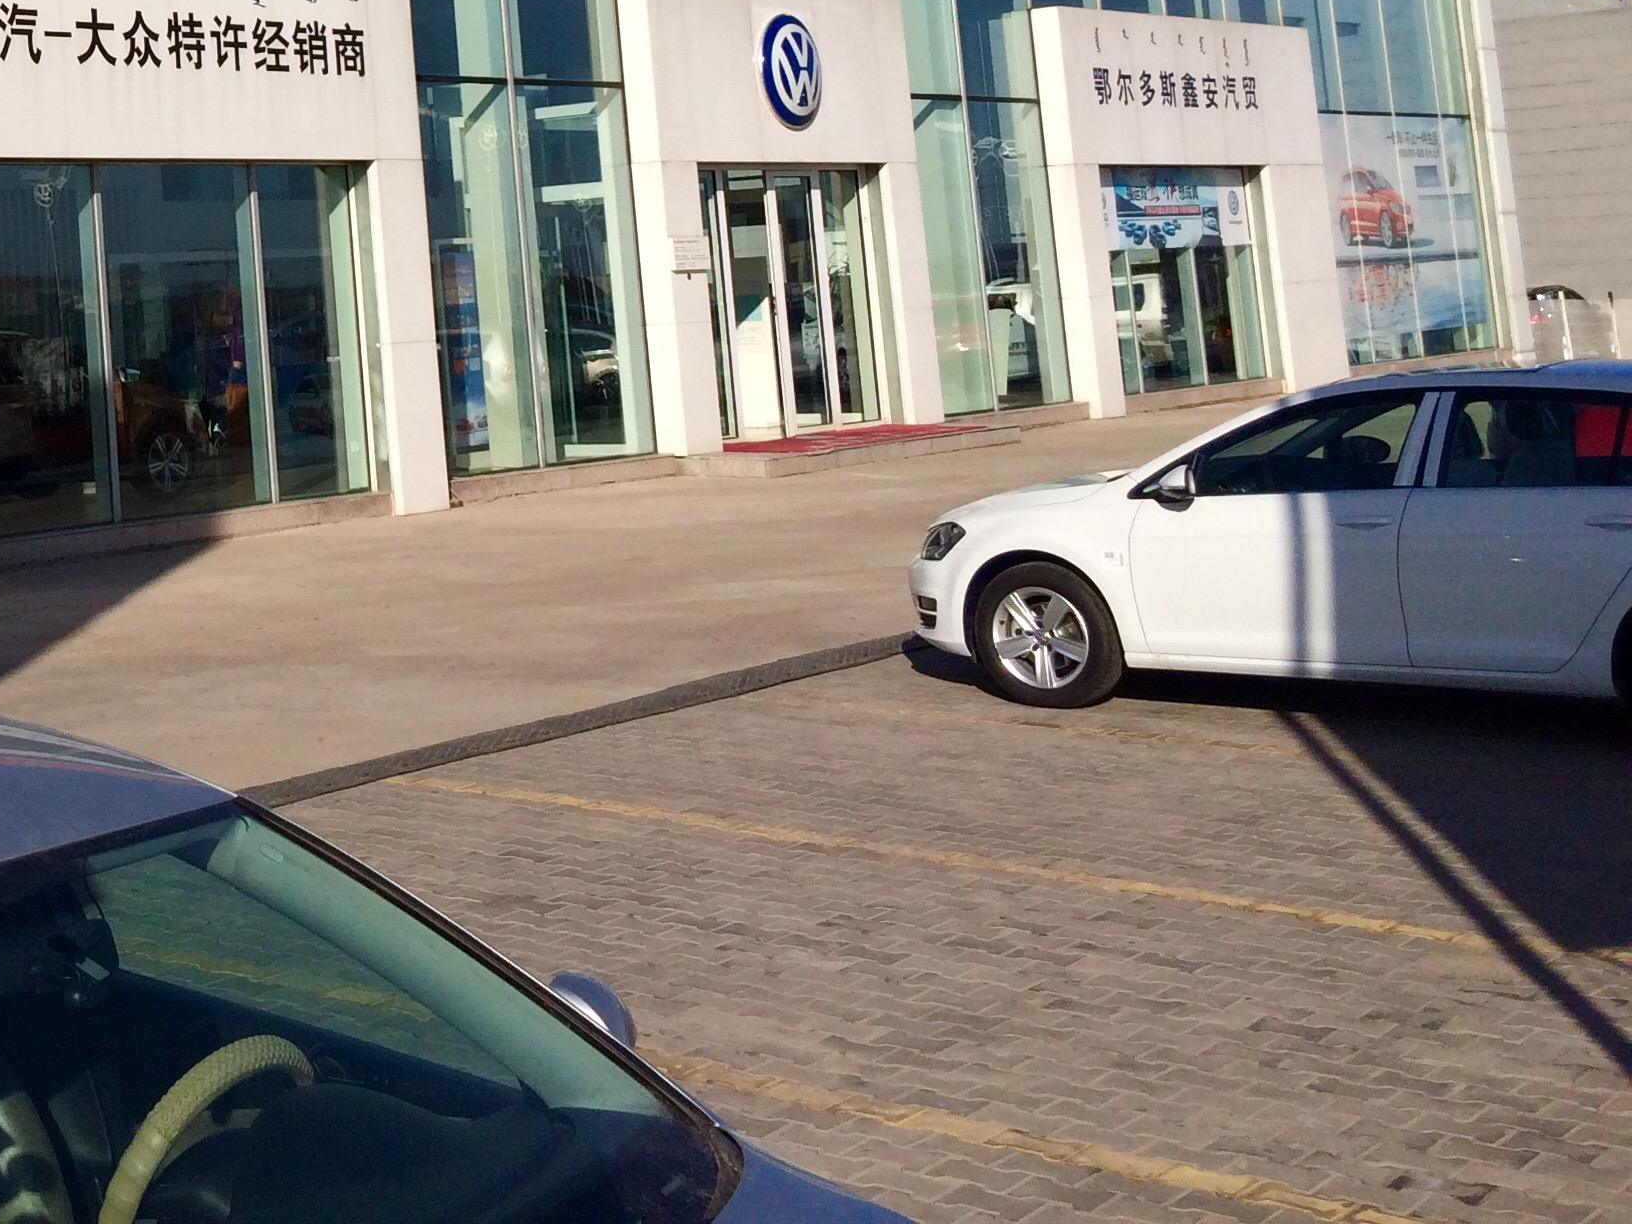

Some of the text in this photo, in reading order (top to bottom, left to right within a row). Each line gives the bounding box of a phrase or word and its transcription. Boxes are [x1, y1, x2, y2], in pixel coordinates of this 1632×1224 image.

[1092, 67, 1259, 111] 鄂尔多斯鑫安汽贸
